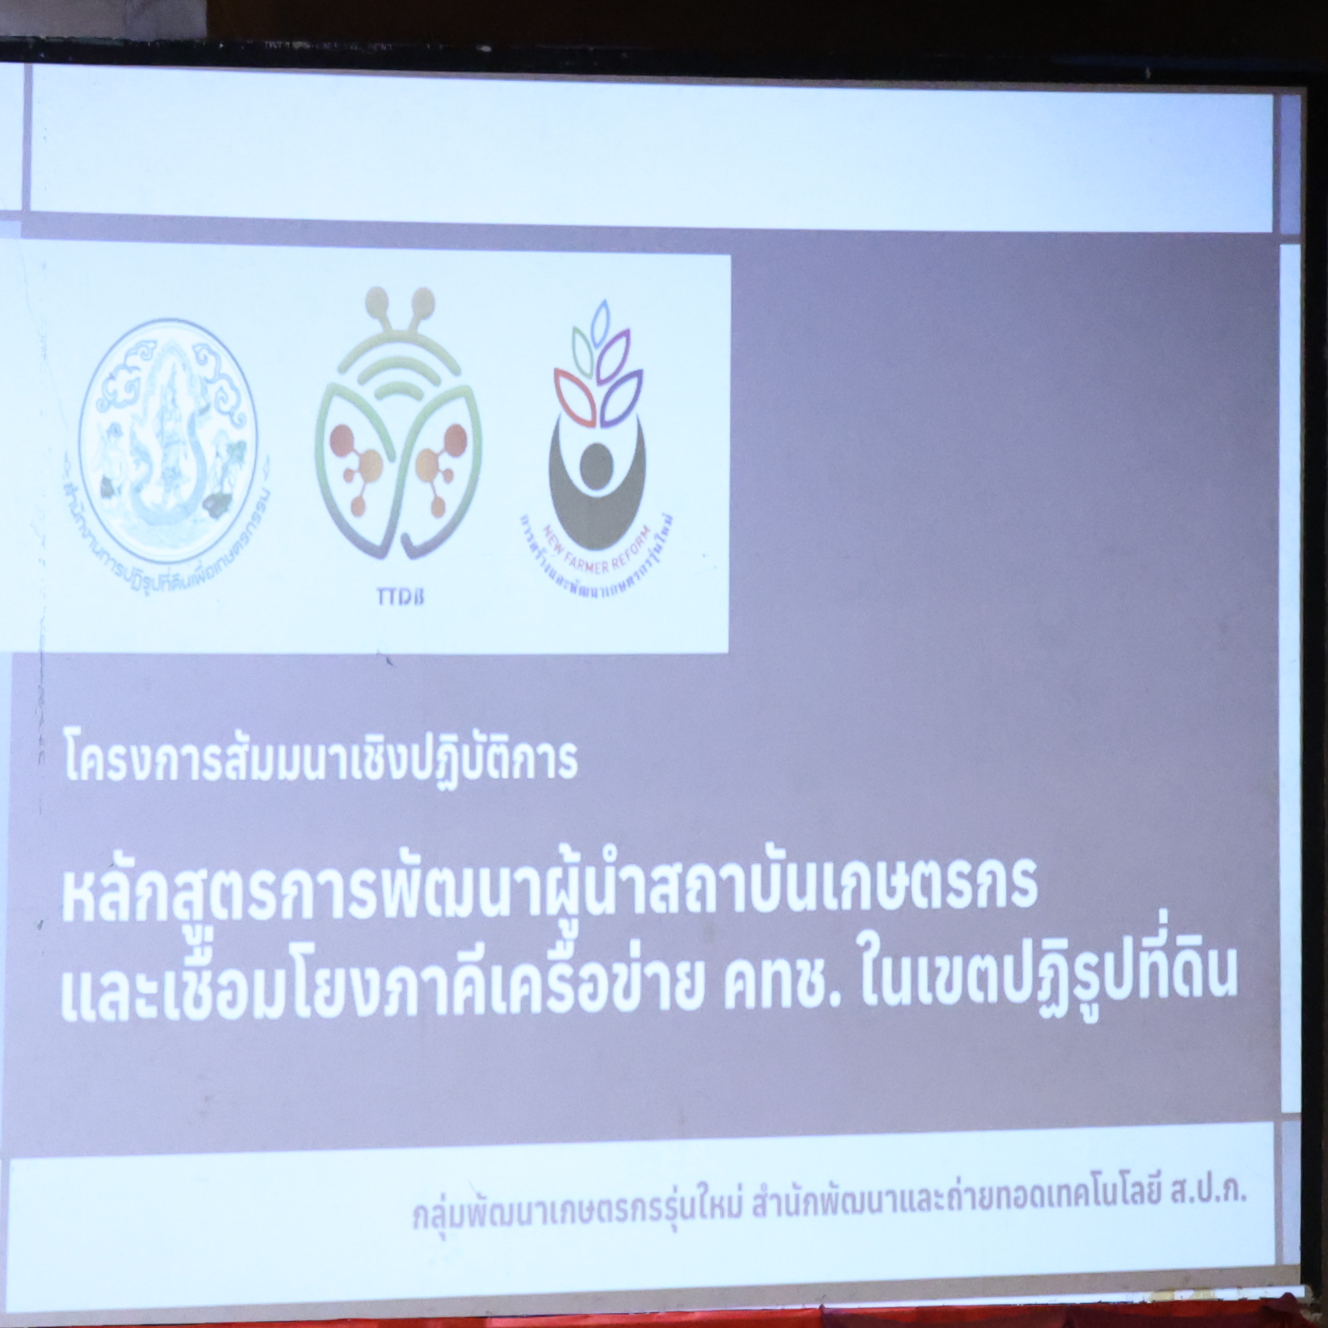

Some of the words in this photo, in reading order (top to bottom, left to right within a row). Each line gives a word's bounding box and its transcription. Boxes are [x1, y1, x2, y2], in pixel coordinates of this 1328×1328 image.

[543, 523, 565, 556] NEW
[563, 551, 610, 575] FARMER
[611, 523, 652, 571] REFORM
[62, 725, 579, 792] โครงการสัมมนาเชิงปฏิบัติการ
[61, 841, 1040, 946] หลักสูตรการพัฒนาผู้นำสถาบันเกษตรกร
[61, 924, 706, 1023] และเชื่อมโยงภาคีเครือข่าย
[724, 958, 842, 1010] คทช.
[855, 907, 1238, 1024] ในเขตปฏิรูปที่ดิน
[411, 1180, 744, 1242] กลุ่มพัฒนาเกษตรกรรุ่นใหม่
[752, 1168, 1163, 1219] สำนักพัฒนาและถ่ายทอดเทคโนโลยี
[1170, 1170, 1247, 1205] ส.ป.ก.
